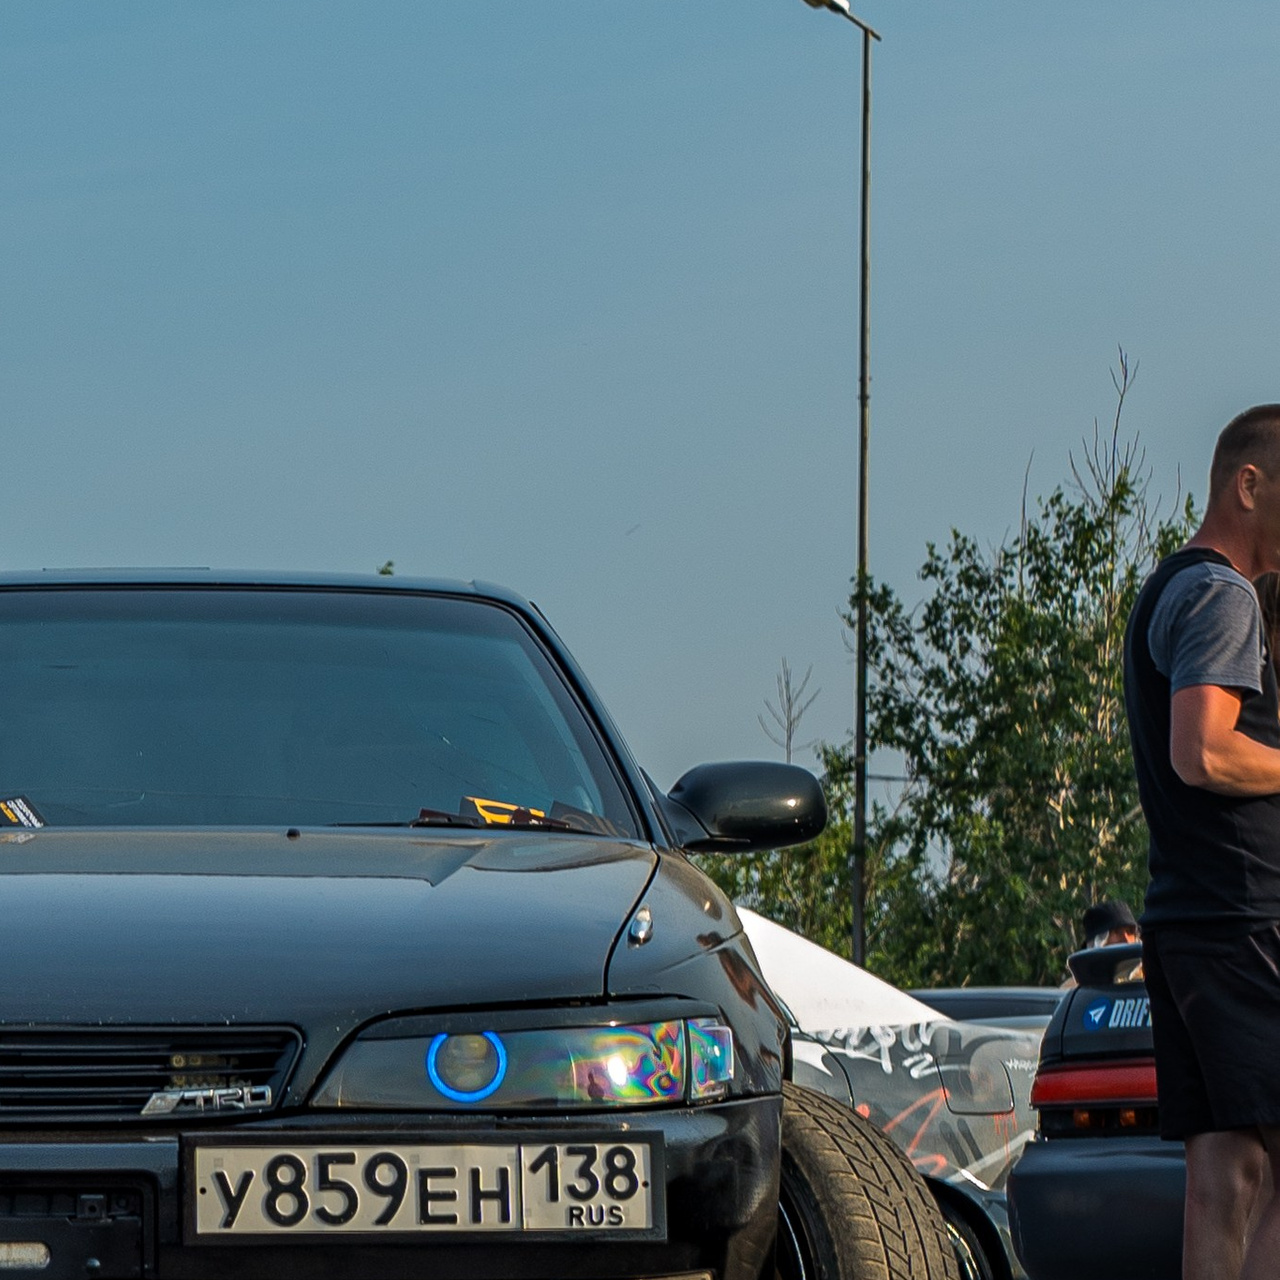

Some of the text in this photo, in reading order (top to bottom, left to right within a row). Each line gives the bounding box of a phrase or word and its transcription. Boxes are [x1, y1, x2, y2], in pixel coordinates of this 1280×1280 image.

[1108, 998, 1152, 1029] DRIF
[182, 1085, 272, 1112] TRD
[214, 1145, 639, 1229] У859ЕН 138
[568, 1205, 625, 1227] RUS
